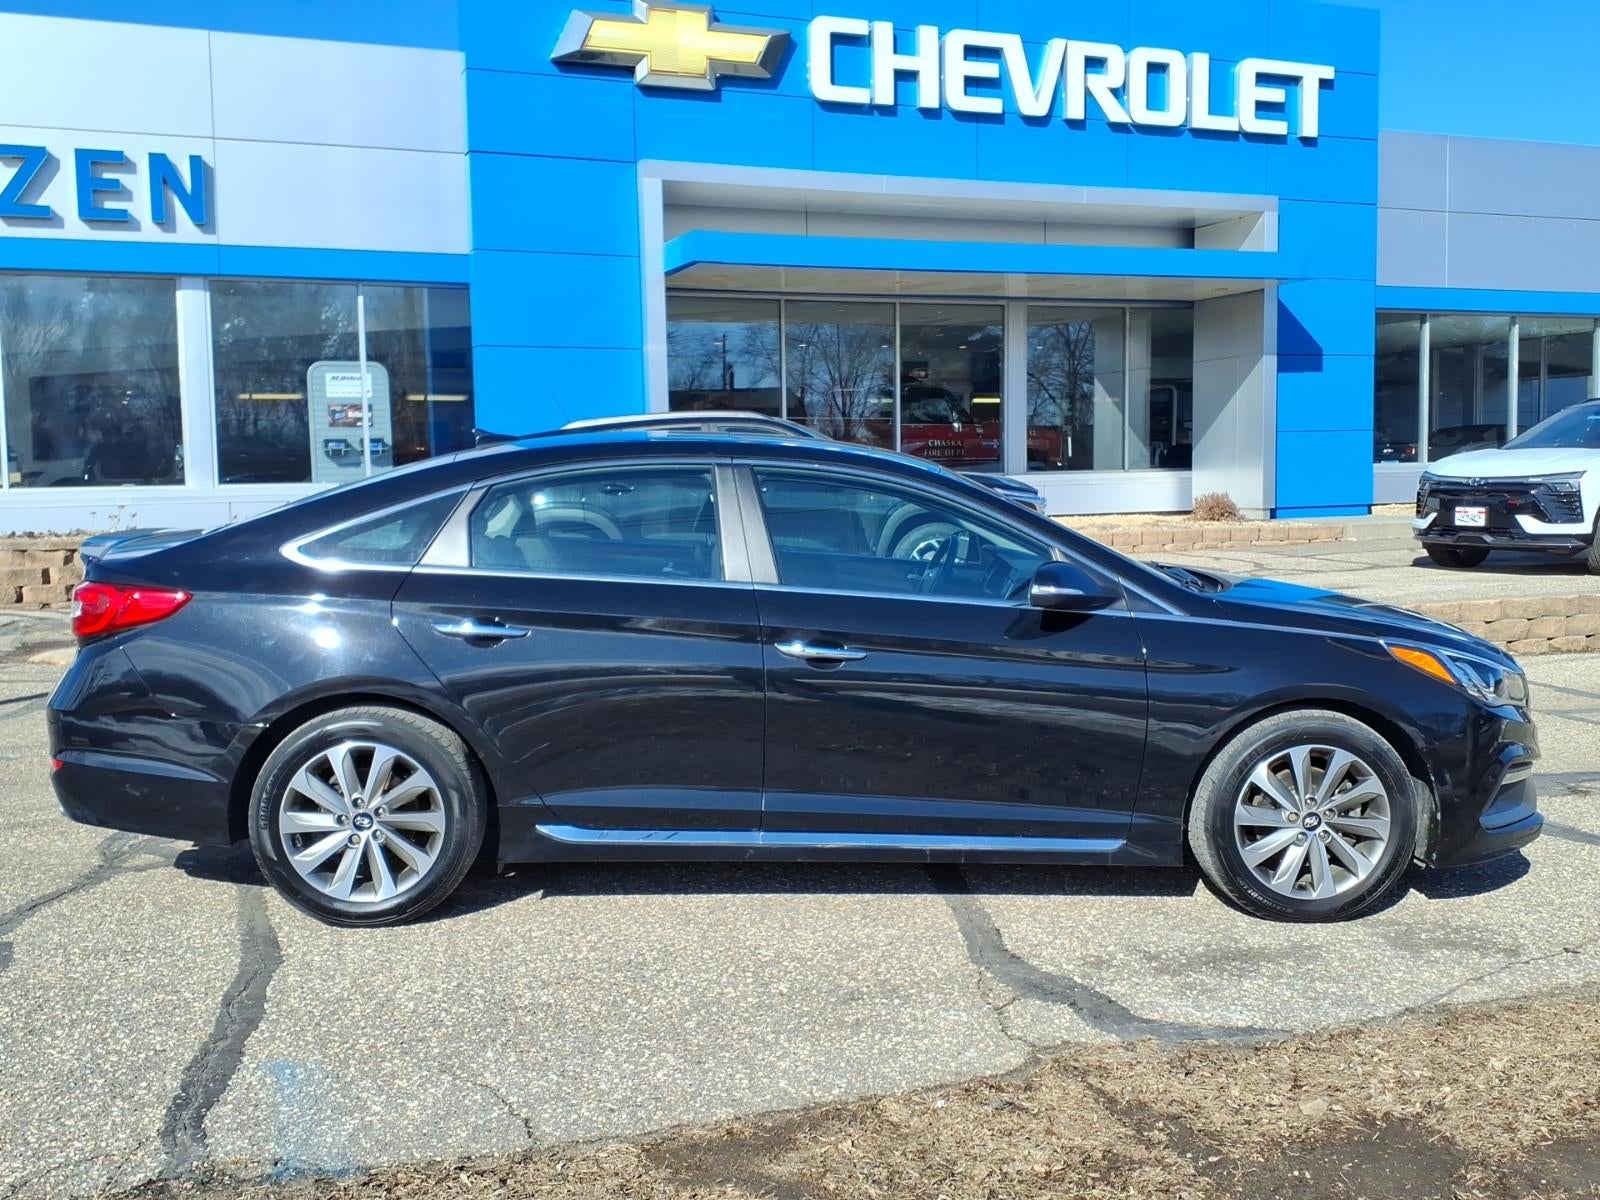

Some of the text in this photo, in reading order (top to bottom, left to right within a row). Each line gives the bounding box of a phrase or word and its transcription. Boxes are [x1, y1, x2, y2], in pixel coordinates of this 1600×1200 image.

[807, 15, 1335, 138] CHEVROLET
[0, 144, 206, 225] ZEN
[924, 448, 943, 457] FIRE
[928, 439, 962, 447] CHASKA
